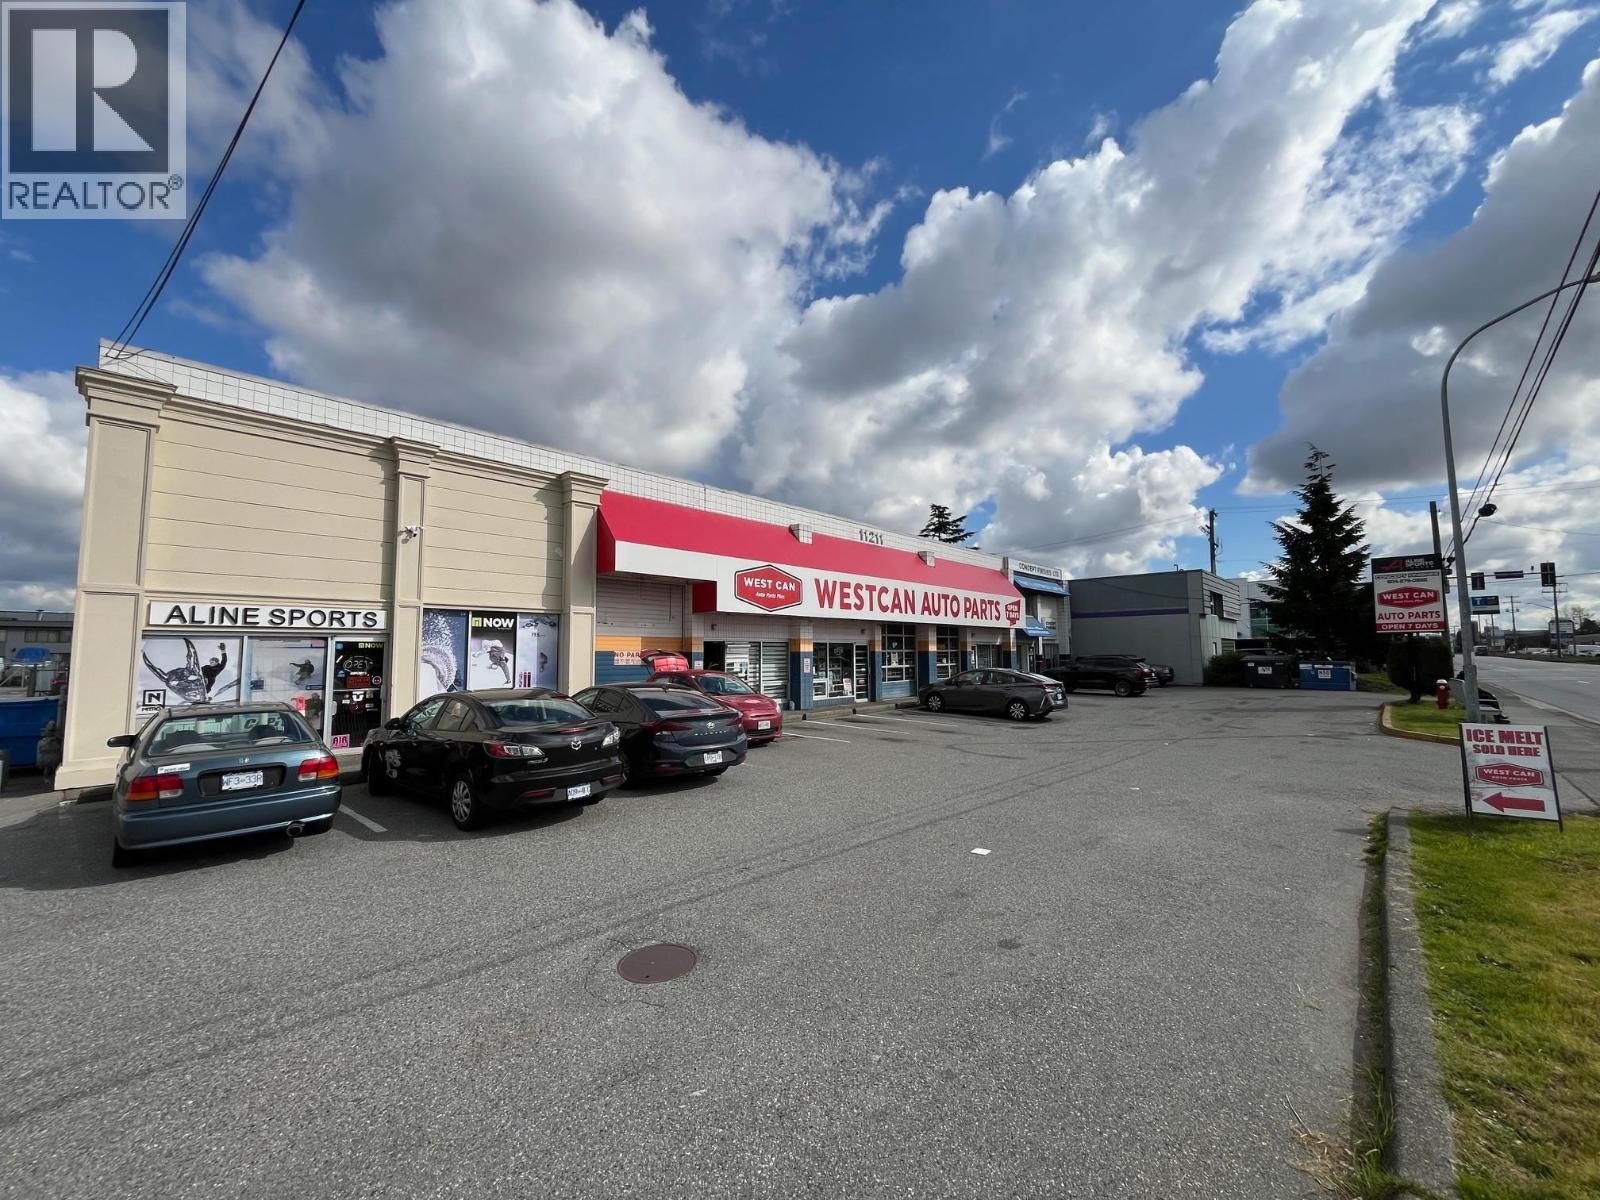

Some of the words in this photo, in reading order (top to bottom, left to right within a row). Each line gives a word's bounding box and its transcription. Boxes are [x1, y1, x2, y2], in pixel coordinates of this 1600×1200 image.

[859, 528, 883, 545] 11211
[744, 576, 773, 589] WEST
[775, 581, 796, 592] CAN
[814, 578, 916, 615] WESTCAN
[920, 591, 960, 618] AUTO
[963, 596, 1001, 621] PARTS
[1382, 592, 1410, 600] WEST
[1413, 591, 1435, 599] CAN
[165, 604, 259, 626] ALINE
[268, 608, 378, 628] SPORTS
[1377, 612, 1405, 621] AUTO
[1408, 610, 1441, 620] PARTS
[483, 617, 515, 628] NOW
[1381, 623, 1406, 631] OPEN
[1415, 622, 1439, 630] DAYS
[1465, 728, 1495, 743] ICE
[1498, 730, 1543, 745] MELT
[1472, 744, 1505, 755] SOLD
[1507, 745, 1541, 757] HERE
[1483, 768, 1510, 776] WEST
